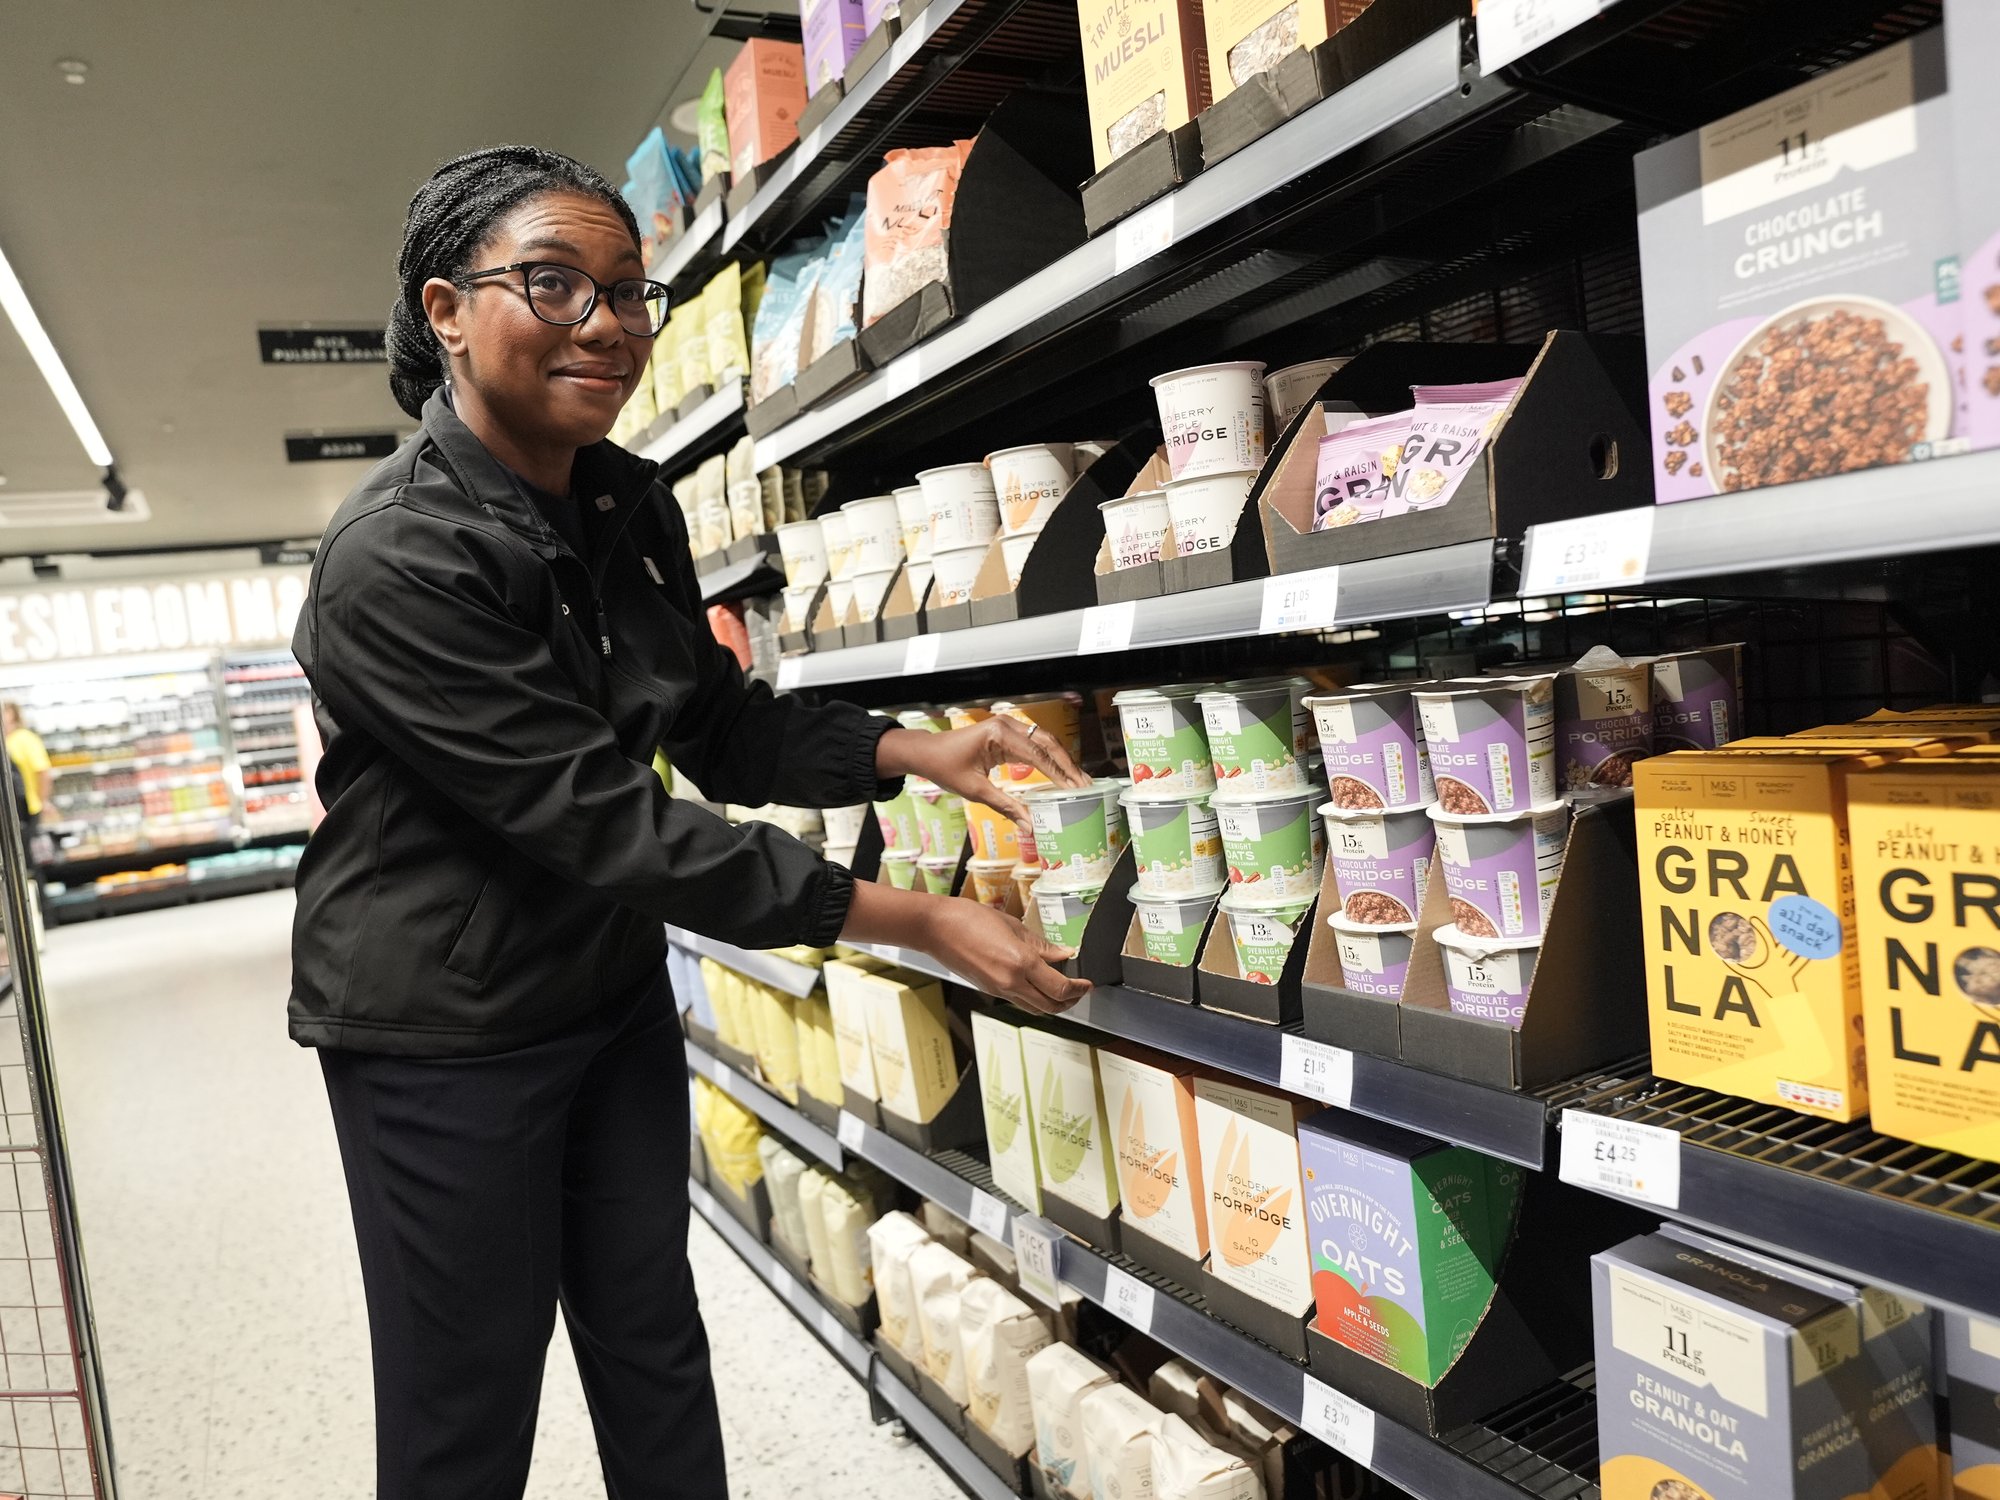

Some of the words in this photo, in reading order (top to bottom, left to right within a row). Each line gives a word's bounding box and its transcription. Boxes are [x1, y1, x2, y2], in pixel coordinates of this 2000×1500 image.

[1095, 12, 1165, 86] MUESLI
[1744, 187, 1867, 246] CHOCOLATE
[1733, 209, 1883, 279] CRUNCH
[1174, 406, 1214, 421] BERRY
[1168, 420, 1198, 434] APPLE
[1430, 423, 1439, 433] &
[1441, 424, 1480, 437] RAISIN
[1401, 434, 1481, 466] GRA
[1317, 474, 1334, 488] NUT
[1333, 470, 1341, 480] &
[1344, 460, 1377, 478] RAISIN
[1024, 480, 1057, 490] SYRUP
[1127, 542, 1160, 552] APPLE
[1606, 688, 1631, 705] 15g
[1605, 703, 1632, 712] Protein
[1595, 716, 1641, 729] CHOCOLATE
[1133, 747, 1168, 757] OATS
[1710, 781, 1737, 791] M&S
[1224, 818, 1240, 830] 13g
[1661, 807, 1695, 823] salty
[1342, 835, 1363, 847] 15g
[1654, 823, 1713, 841] PEANUT
[1721, 827, 1731, 842] &
[1738, 828, 1797, 846] HONEY
[1886, 822, 1933, 840] salty
[1226, 851, 1255, 861] OATS
[1877, 841, 1958, 862] PEANUT
[1970, 846, 1983, 863] &
[1339, 860, 1377, 868] CHOCOLATE
[1655, 845, 1810, 902] GRA
[1251, 923, 1272, 937] 13g
[1779, 907, 1802, 926] all
[1807, 922, 1834, 943] day
[1780, 923, 1823, 950] snack
[1147, 942, 1177, 952] OATS
[1247, 946, 1284, 955] OVERNIGHT
[1342, 945, 1360, 960] 15g
[1247, 955, 1286, 965] OATS
[1466, 964, 1493, 982] 15g
[1462, 993, 1509, 1005] CHOCOLATE
[1664, 965, 1761, 1028] LA
[1304, 1058, 1326, 1075] £1.15
[1234, 1099, 1248, 1109] M&S
[1040, 1122, 1093, 1150] PORRIDGE
[1127, 1136, 1161, 1156] GOLDEN
[1132, 1148, 1158, 1163] SYRUP
[1343, 1151, 1359, 1164] M&S
[1595, 1141, 1637, 1163] £4.25
[1120, 1151, 1179, 1188] PORRIDGE
[1227, 1173, 1270, 1194] GOLDEN
[1428, 1175, 1473, 1200] OVERNIGHT
[1147, 1192, 1156, 1202] 10
[1232, 1186, 1266, 1204] SYRUP
[1432, 1192, 1472, 1214] OATS
[1136, 1196, 1171, 1219] SACHETS
[1213, 1192, 1291, 1230] PORRIDGE
[1310, 1193, 1413, 1258] OVERNIGHT
[1018, 1229, 1046, 1254] PICK
[1248, 1236, 1259, 1247] 10
[1023, 1247, 1047, 1277] ME!
[1232, 1241, 1278, 1266] SACHETS
[1321, 1239, 1406, 1296] OATS
[1674, 1253, 1770, 1293] GRANOLA
[1358, 1304, 1371, 1315] WITH
[1670, 1304, 1693, 1320] M&S
[1344, 1306, 1362, 1324] APPLE
[1369, 1319, 1390, 1338] SEEDS
[1663, 1325, 1703, 1364] 11g
[1662, 1348, 1706, 1376] Protein
[1637, 1373, 1692, 1412] PEANUT
[1695, 1399, 1705, 1418] &
[1710, 1409, 1739, 1434] OAT
[1868, 1381, 1928, 1422] GRANOLA
[1324, 1404, 1350, 1426] £3.70
[1630, 1389, 1749, 1463] GRANOLA
[1797, 1427, 1861, 1471] GRANOLA
